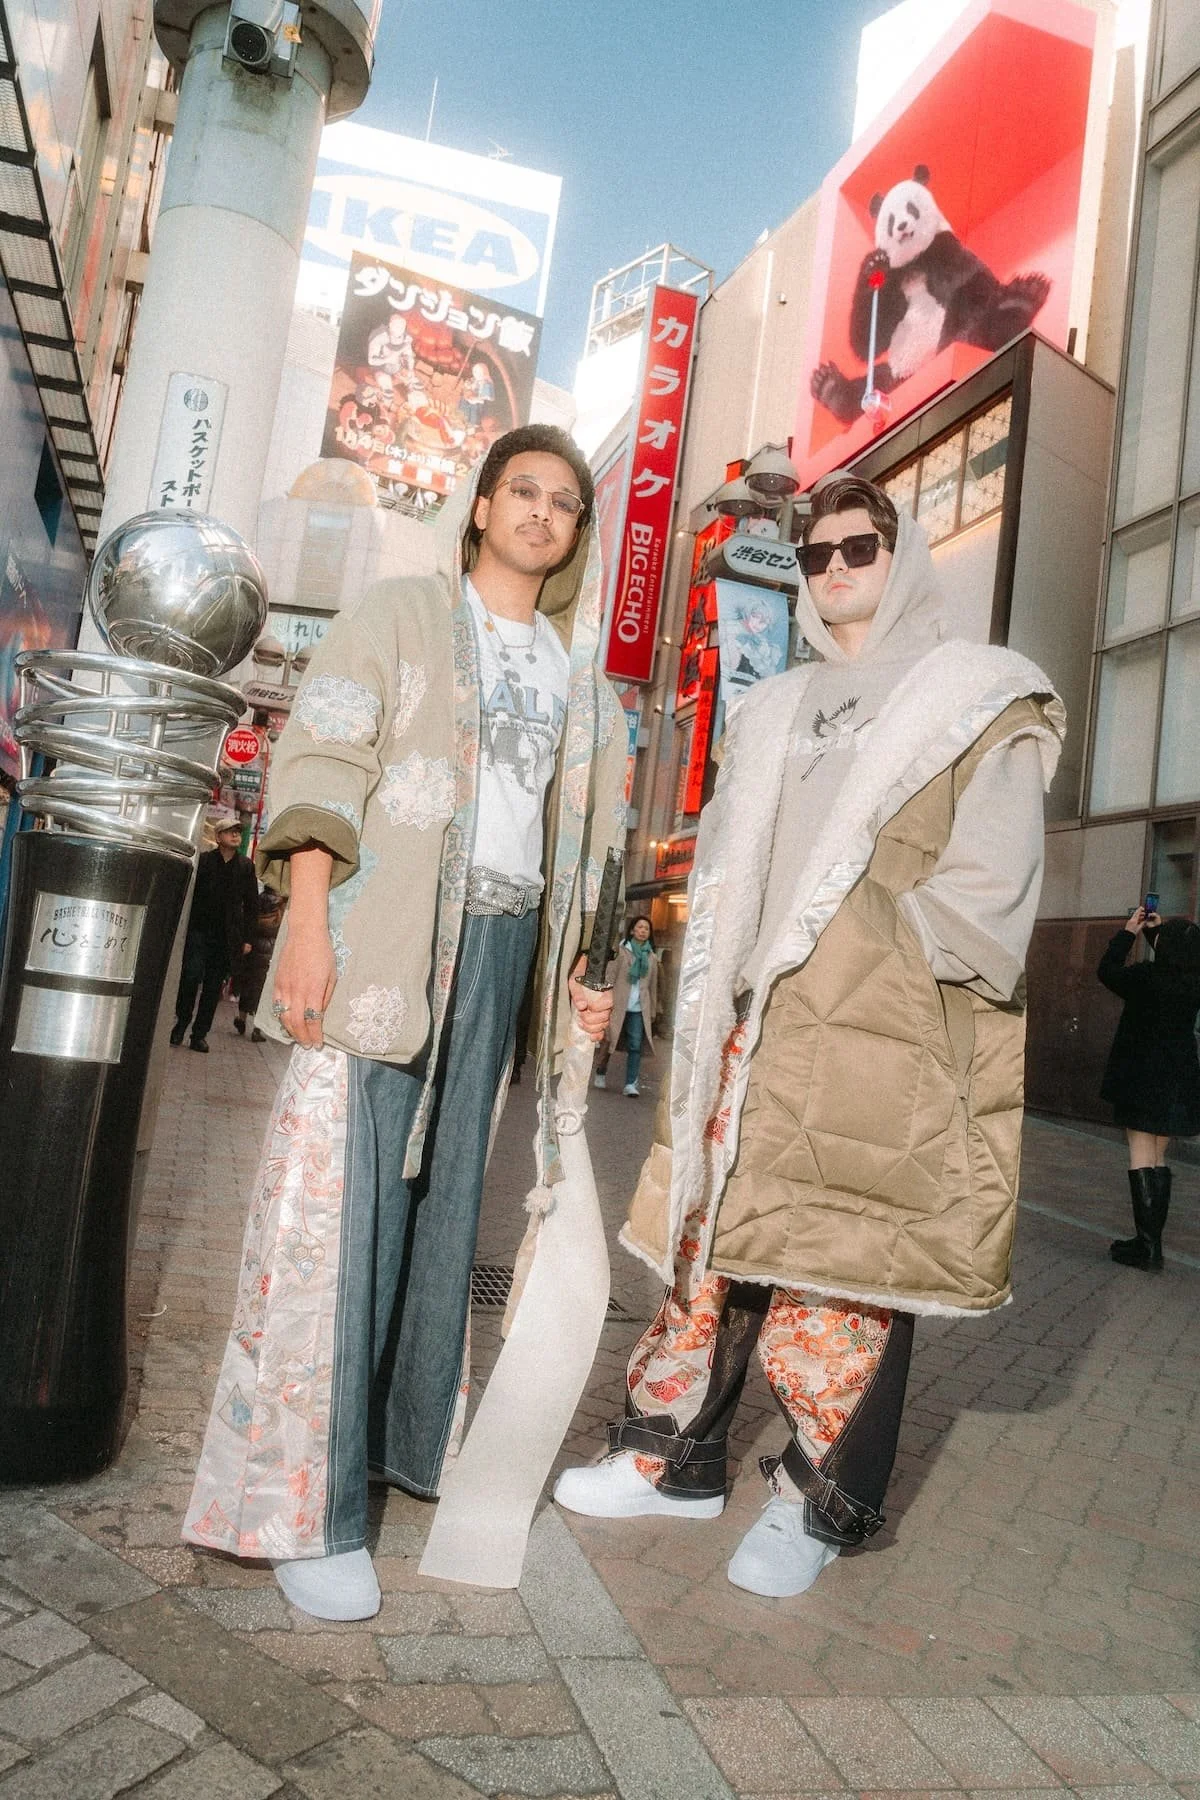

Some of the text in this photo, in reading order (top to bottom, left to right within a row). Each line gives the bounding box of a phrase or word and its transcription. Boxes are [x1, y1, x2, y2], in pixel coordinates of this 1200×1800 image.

[308, 188, 519, 276] IKEA
[354, 266, 536, 357] ダンジョン飯
[632, 315, 689, 498] カラオケ
[617, 521, 654, 644] BIG ECHO
